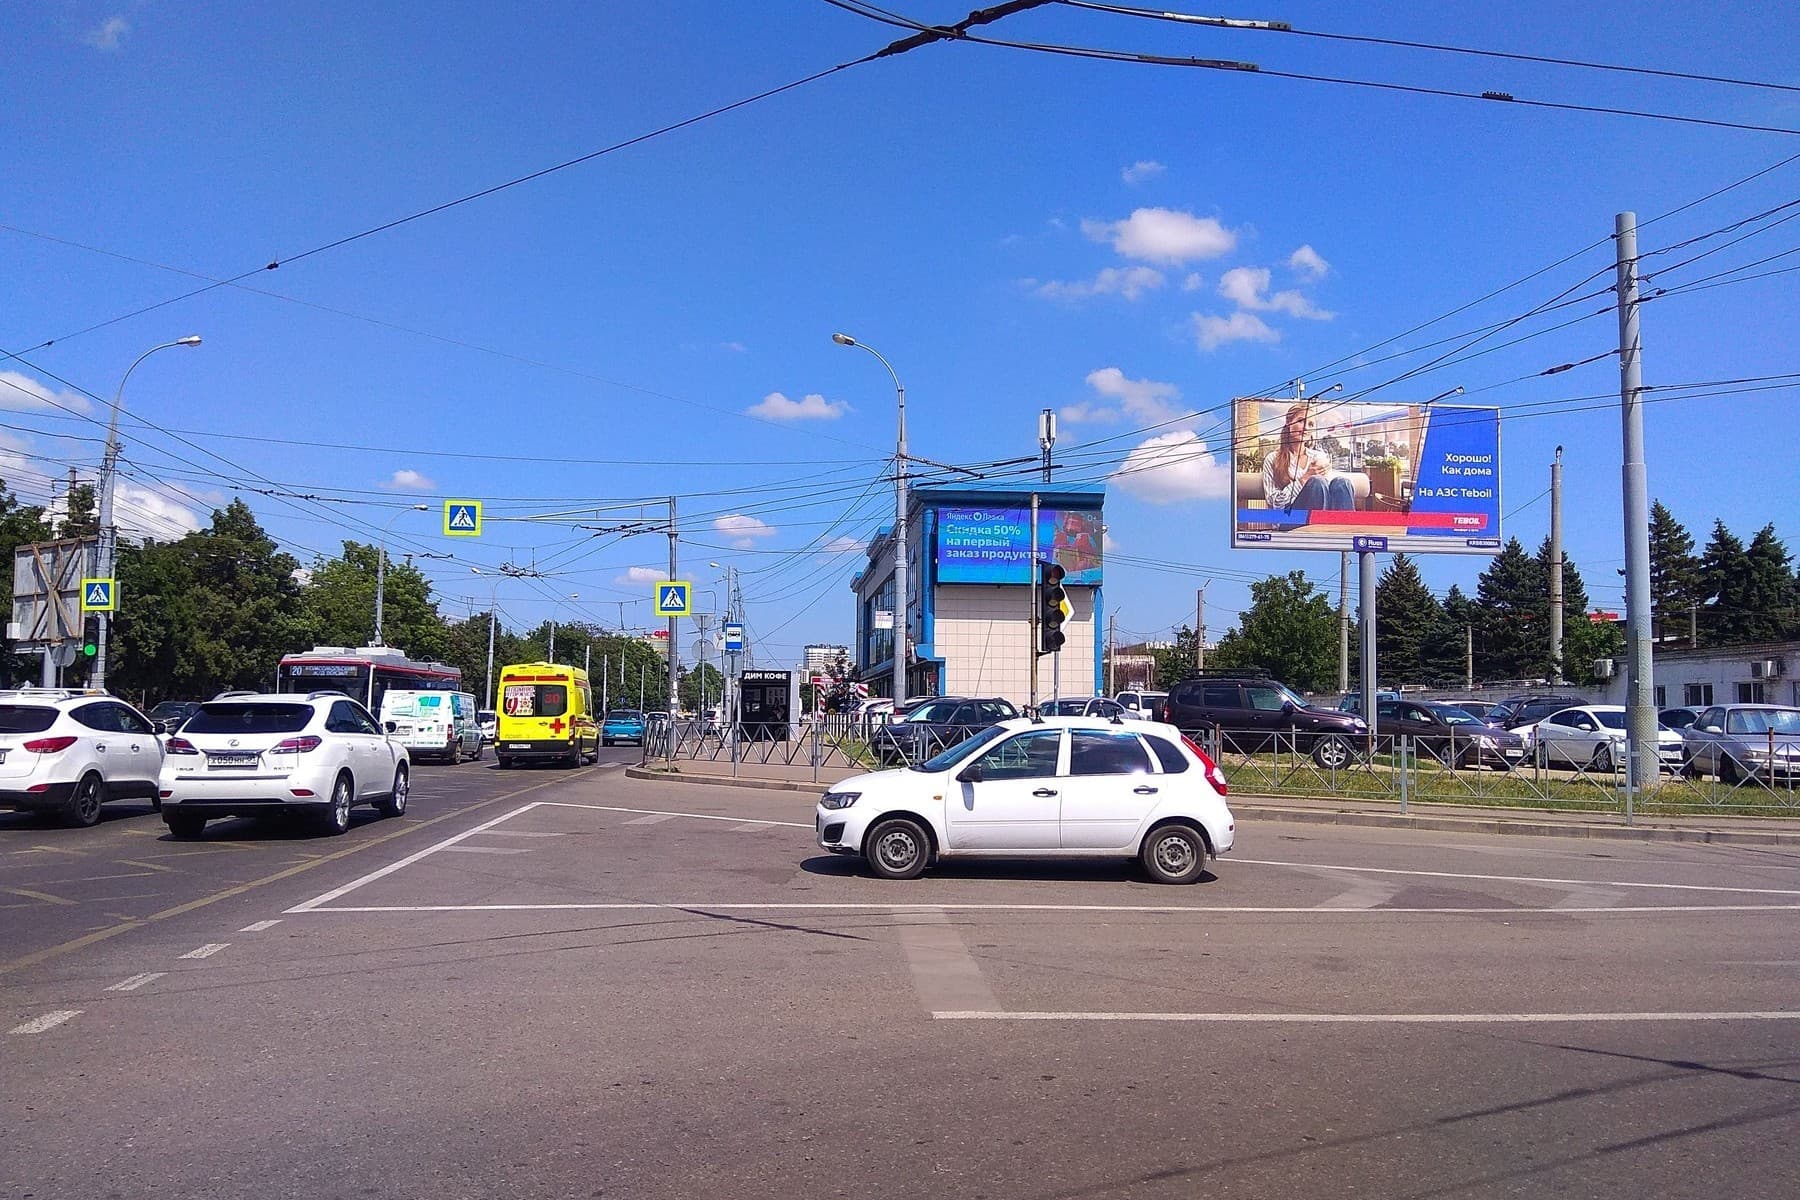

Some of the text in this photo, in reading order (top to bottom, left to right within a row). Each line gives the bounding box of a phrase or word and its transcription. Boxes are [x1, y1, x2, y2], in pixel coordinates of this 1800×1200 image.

[1445, 453, 1492, 464] Хорошо!
[1442, 465, 1492, 476] Как дома
[1419, 488, 1492, 498] На АЗС Teboil
[946, 512, 973, 521] Яндекс
[1453, 517, 1481, 525] TEBOIL
[946, 524, 1021, 536] Скидка 50%
[946, 536, 1010, 549] на первый
[946, 549, 979, 559] заказ
[291, 666, 302, 676] 20
[744, 672, 787, 680] ДИМ КОФЕ
[543, 693, 561, 705] 30
